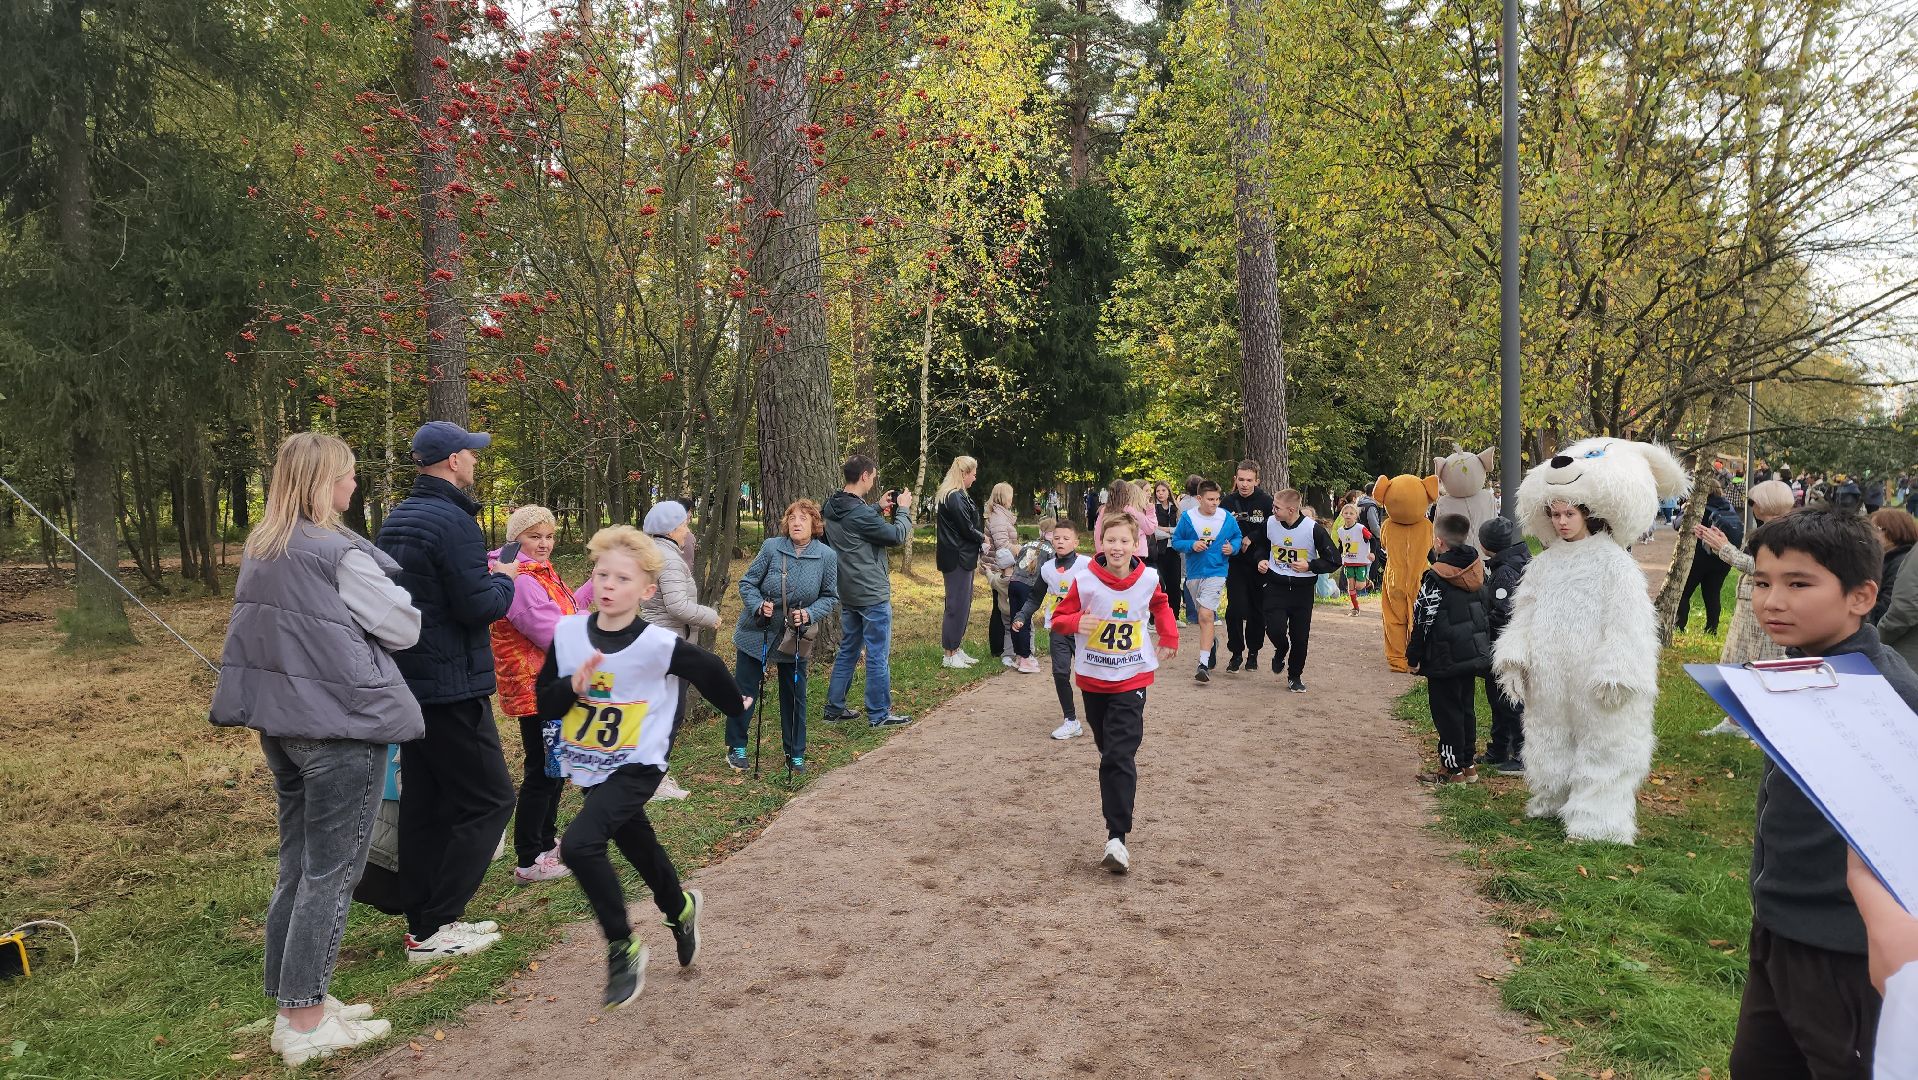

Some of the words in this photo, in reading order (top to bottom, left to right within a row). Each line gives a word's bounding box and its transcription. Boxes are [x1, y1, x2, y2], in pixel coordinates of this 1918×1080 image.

[1277, 547, 1298, 563] 29
[1100, 623, 1133, 650] 43
[576, 701, 623, 748] 73
